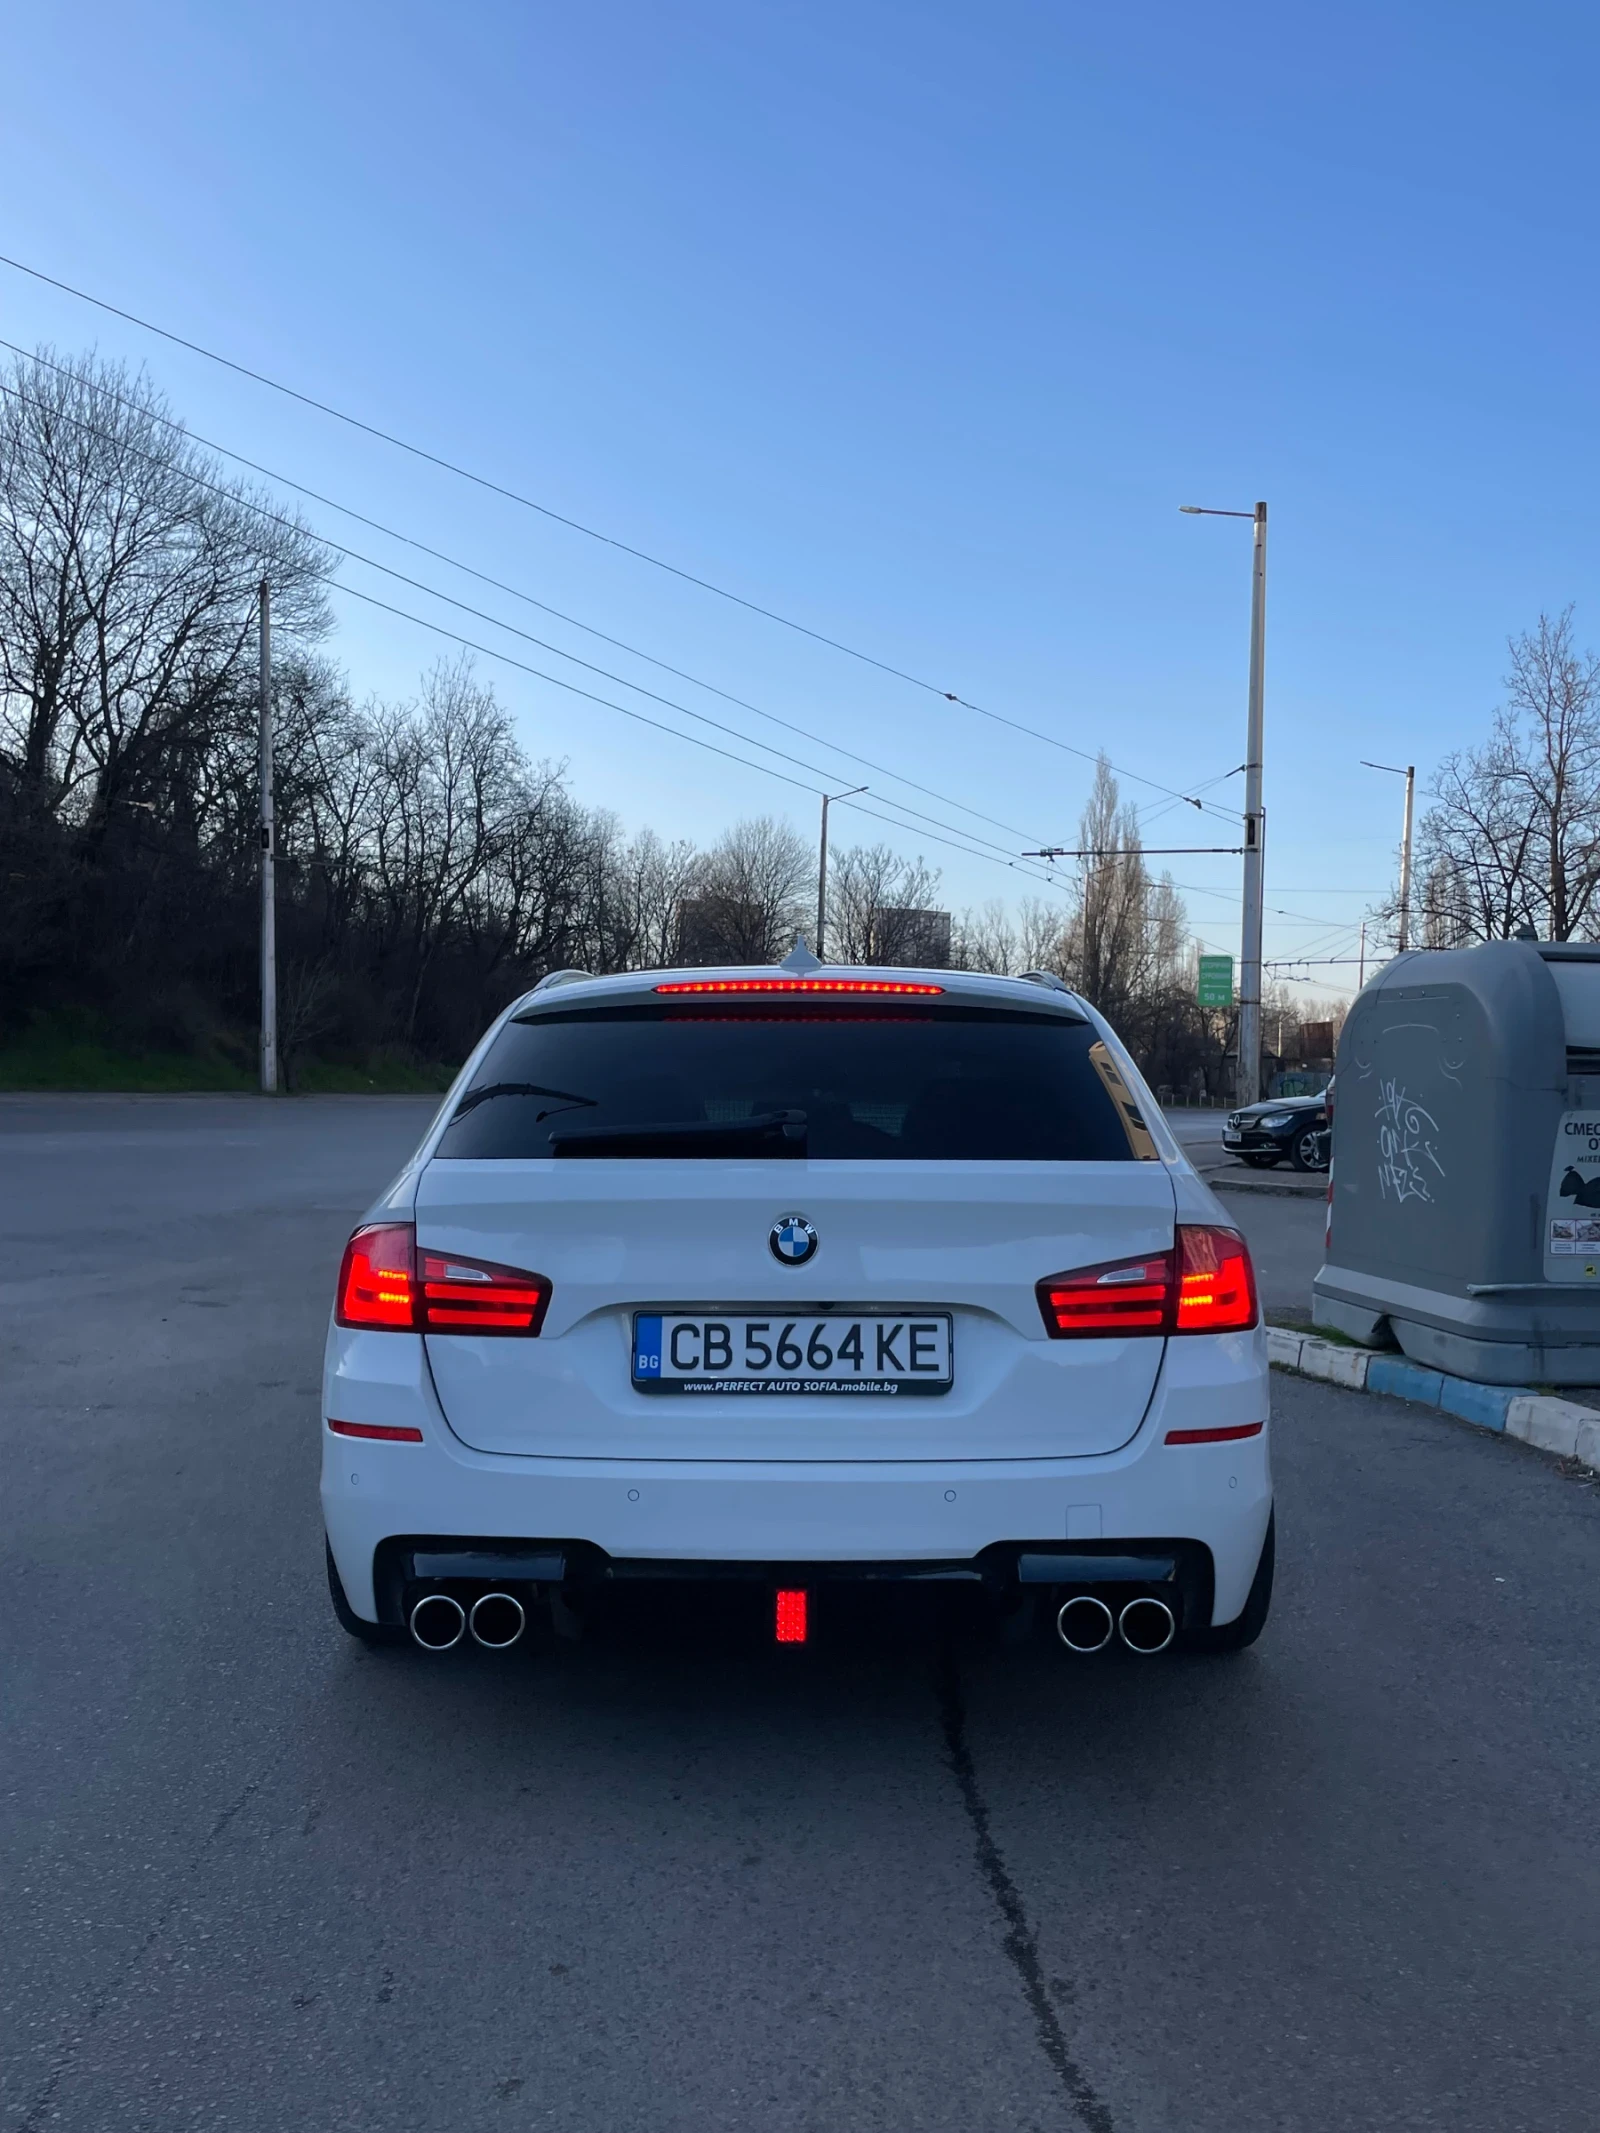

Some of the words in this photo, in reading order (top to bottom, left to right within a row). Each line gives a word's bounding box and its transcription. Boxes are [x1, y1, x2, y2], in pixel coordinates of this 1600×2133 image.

[1204, 992, 1215, 1001] 50
[773, 1218, 816, 1234] BMW
[638, 1354, 659, 1369] BG
[683, 1381, 766, 1391] www.PERFECT
[767, 1382, 800, 1391] AUTO
[803, 1382, 899, 1394] SOFIA.mobile.bg
